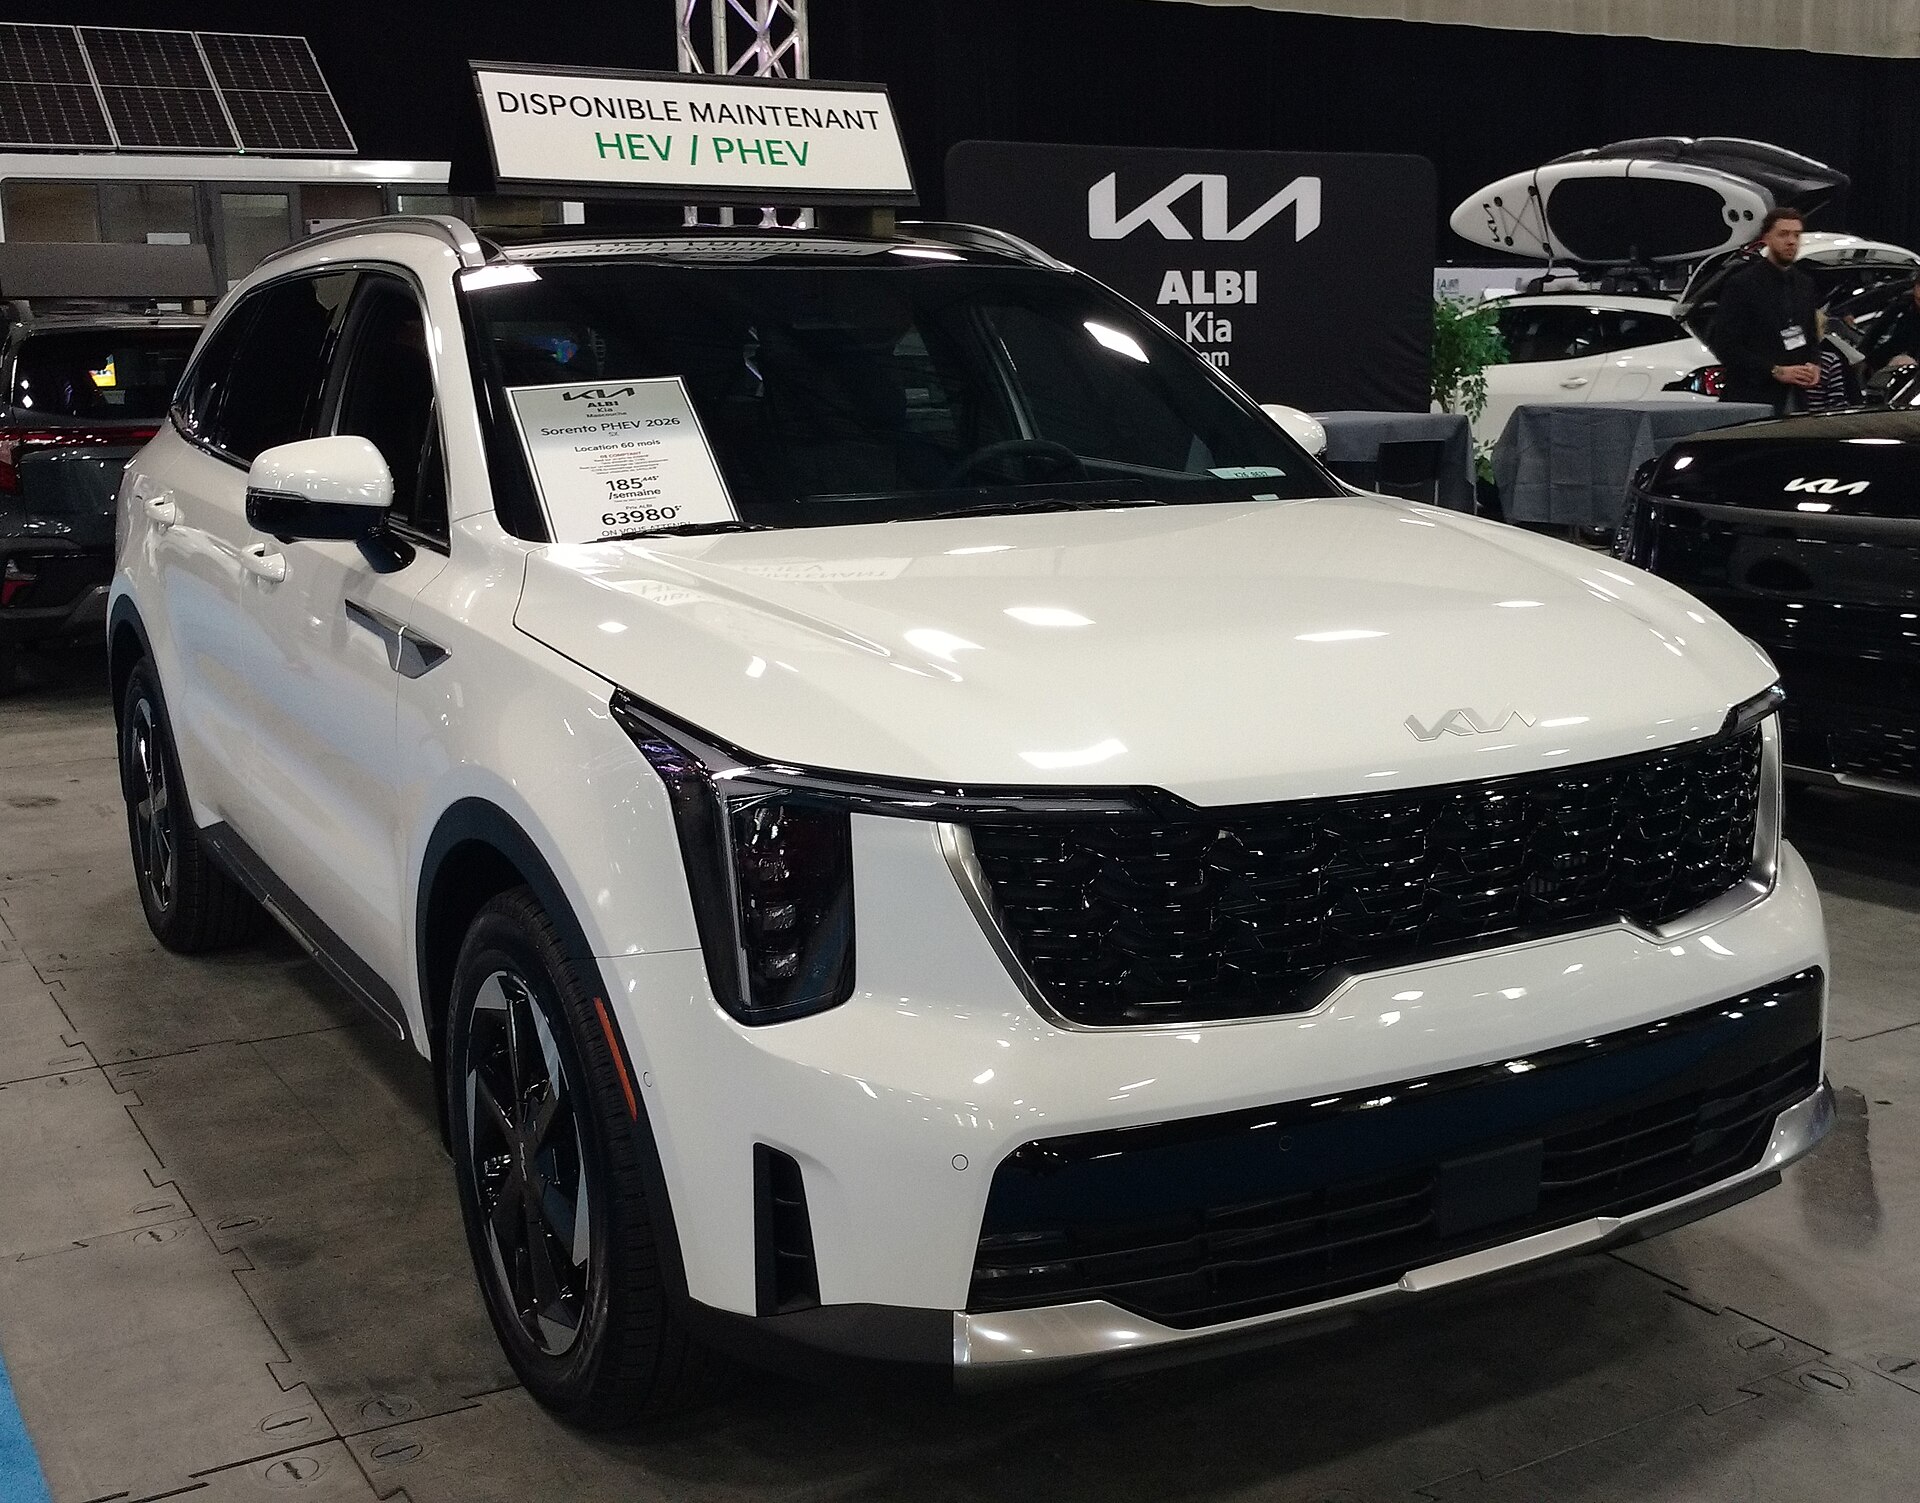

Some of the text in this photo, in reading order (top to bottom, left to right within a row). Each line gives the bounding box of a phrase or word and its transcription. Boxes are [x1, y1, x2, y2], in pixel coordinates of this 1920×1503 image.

[497, 91, 880, 131] DISPONIBLE MAINTENANT
[595, 131, 810, 168] HEV / PHEV
[1088, 171, 1321, 243] KIA
[1156, 270, 1258, 305] ALBI
[1185, 311, 1233, 343] Kia
[562, 387, 636, 401] KIA
[541, 417, 681, 437] Sorento PHEV 2026
[574, 439, 661, 453] Location 60 mois
[608, 488, 661, 500] /semaine
[1783, 477, 1871, 496] KIA
[601, 529, 618, 537] ON
[1403, 702, 1537, 742] KIA
